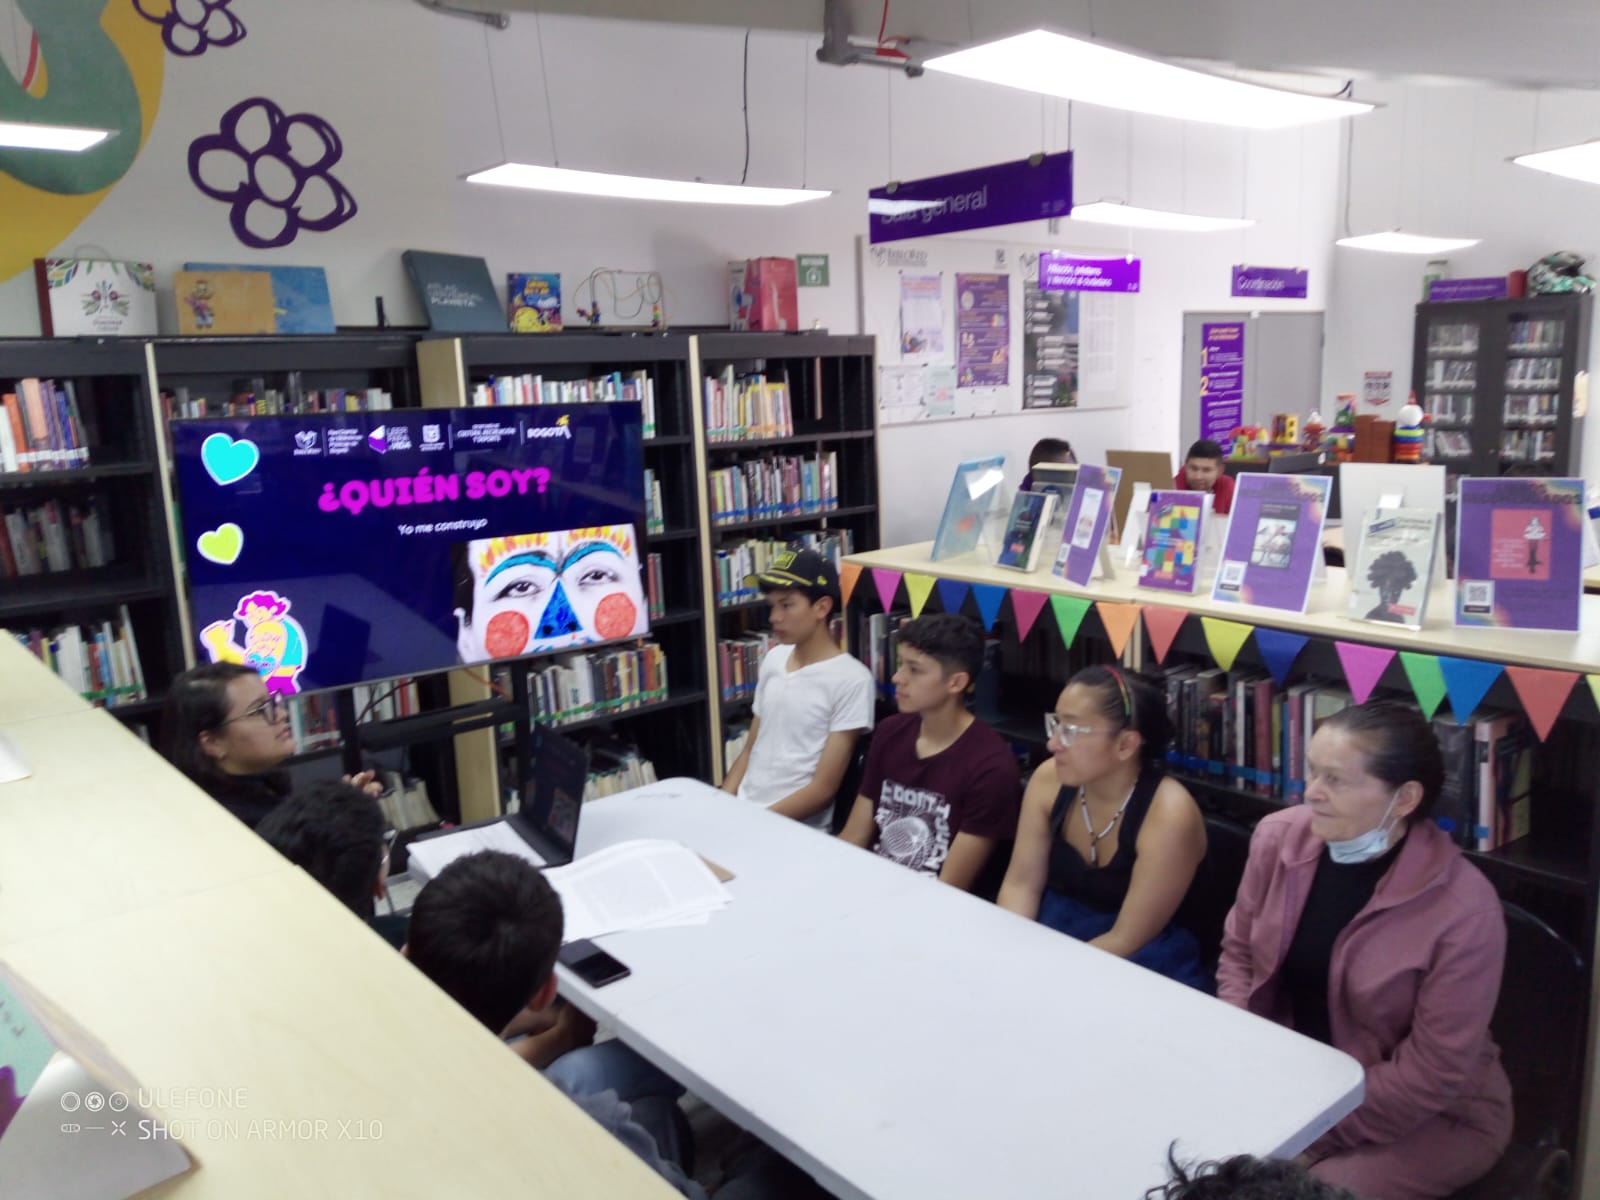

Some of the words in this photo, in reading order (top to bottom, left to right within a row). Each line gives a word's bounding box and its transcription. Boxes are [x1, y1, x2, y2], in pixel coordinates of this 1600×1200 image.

[921, 185, 988, 222] general
[317, 466, 460, 516] ¿QUIÉN
[465, 467, 551, 500] SOY?
[398, 525, 414, 535] Yo
[415, 523, 433, 533] me
[434, 518, 488, 533] construyo
